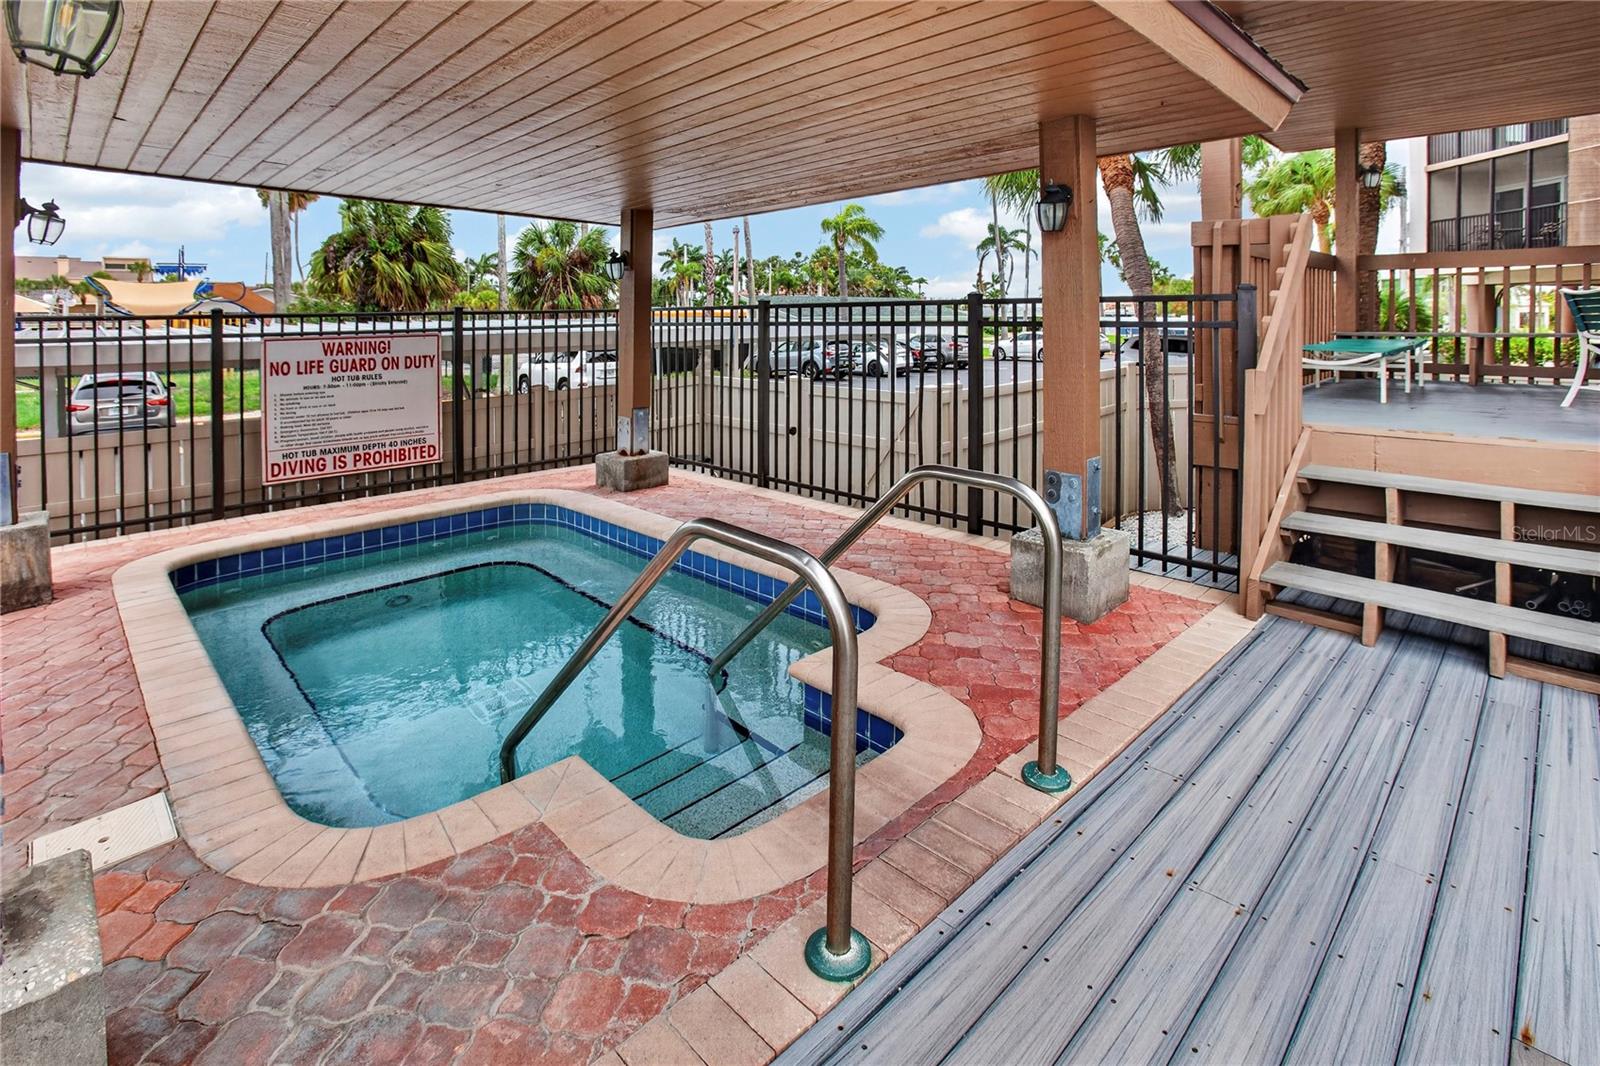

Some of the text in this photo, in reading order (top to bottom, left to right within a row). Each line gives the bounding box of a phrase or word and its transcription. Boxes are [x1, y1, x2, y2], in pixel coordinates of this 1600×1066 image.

[322, 341, 391, 356] WARNING!
[270, 355, 435, 376] NO LIFE GUARD ON DUTY
[282, 452, 299, 460] HOT
[320, 445, 359, 455] MAXIMUM
[362, 442, 386, 451] DEPTH
[400, 438, 427, 446] INCHES
[271, 445, 436, 478] DIVING IS PROHIBITED
